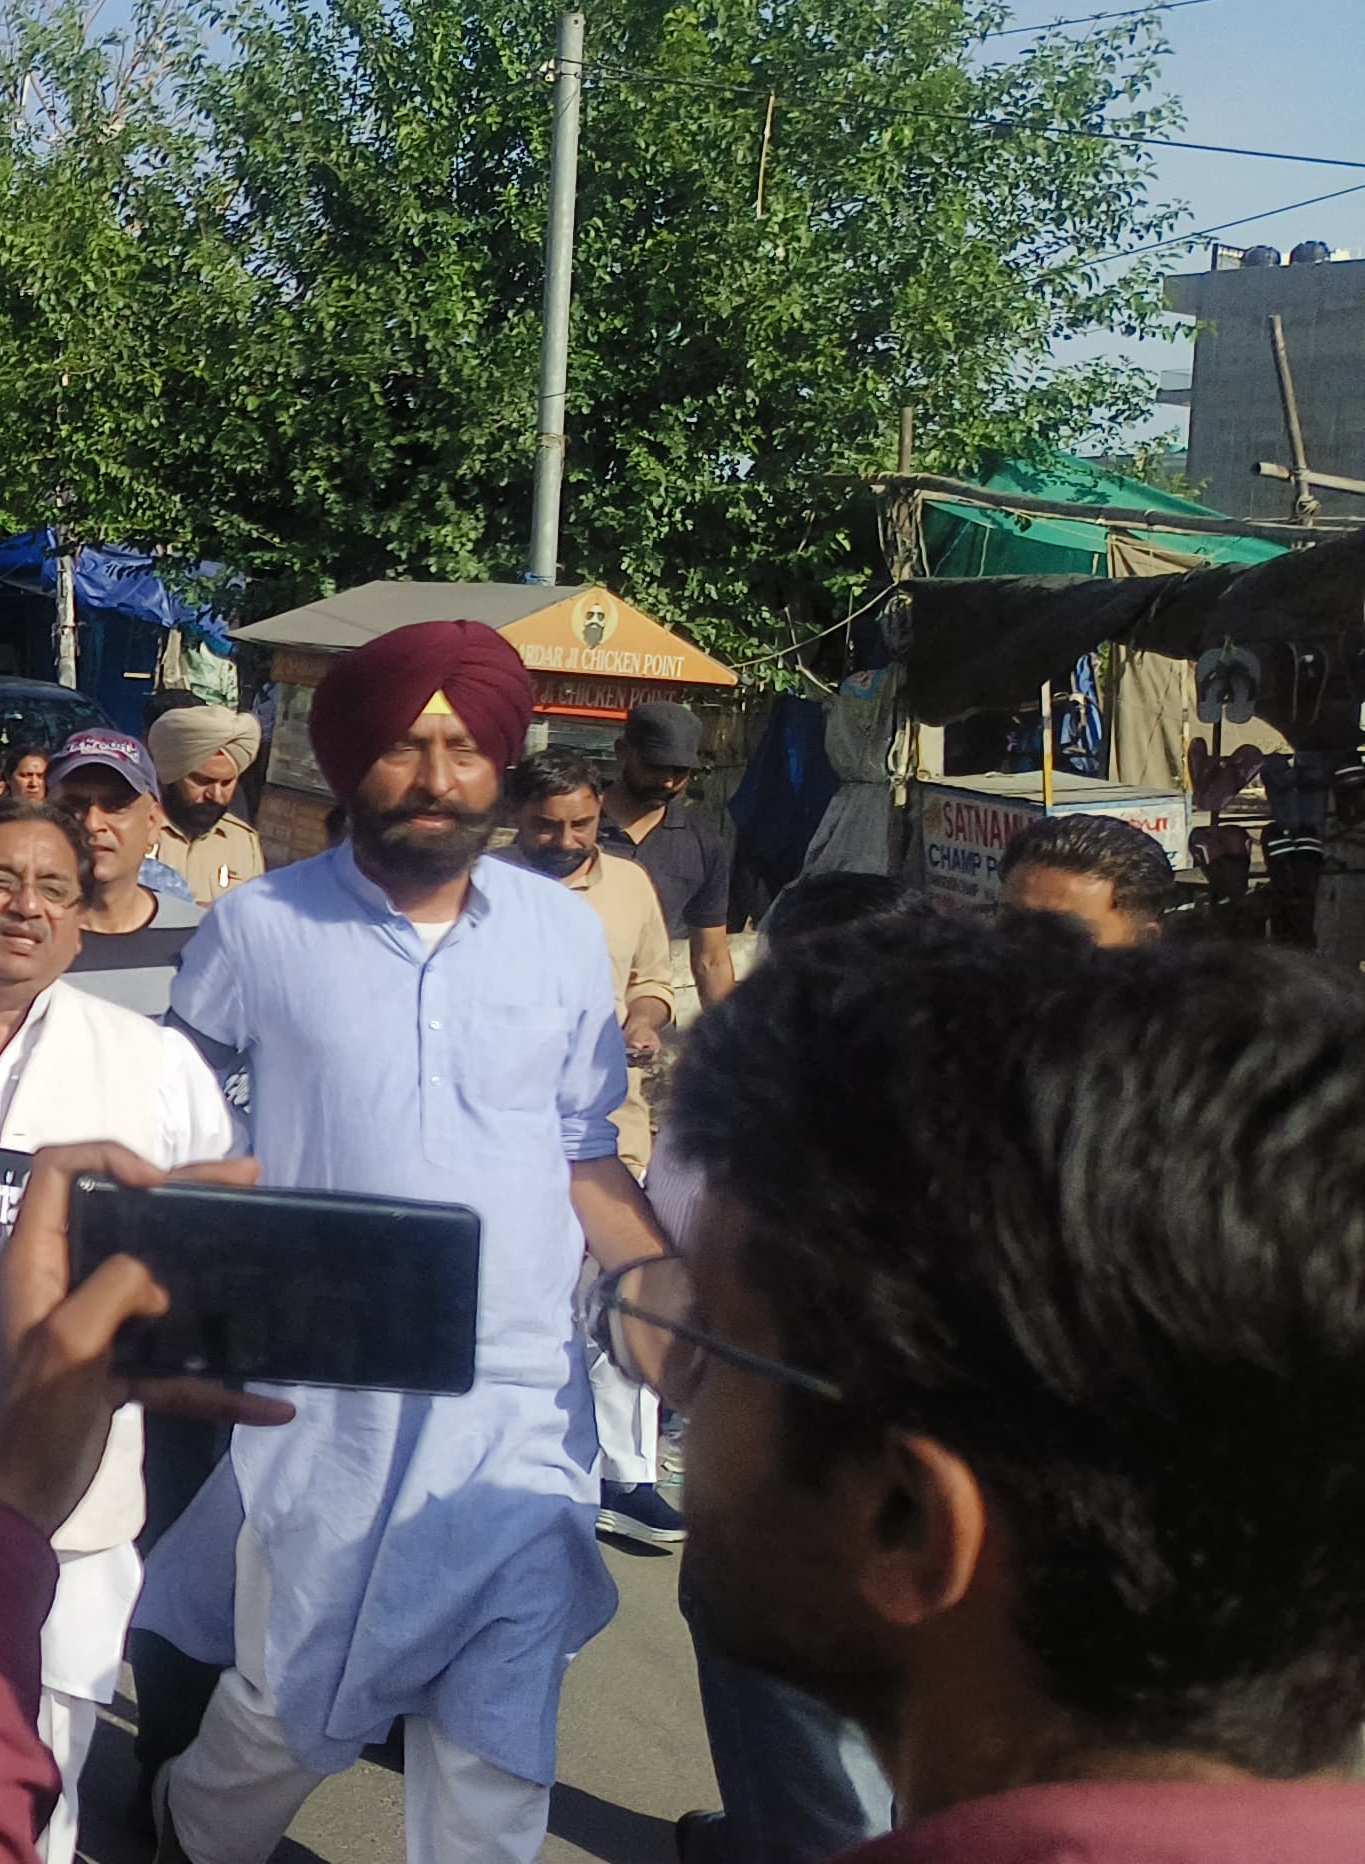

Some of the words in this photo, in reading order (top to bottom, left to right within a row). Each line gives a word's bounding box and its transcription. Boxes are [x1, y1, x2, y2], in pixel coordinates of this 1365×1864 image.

[517, 644, 563, 668] ARDAR
[581, 649, 641, 674] CHICKEN
[643, 653, 685, 678] POINT
